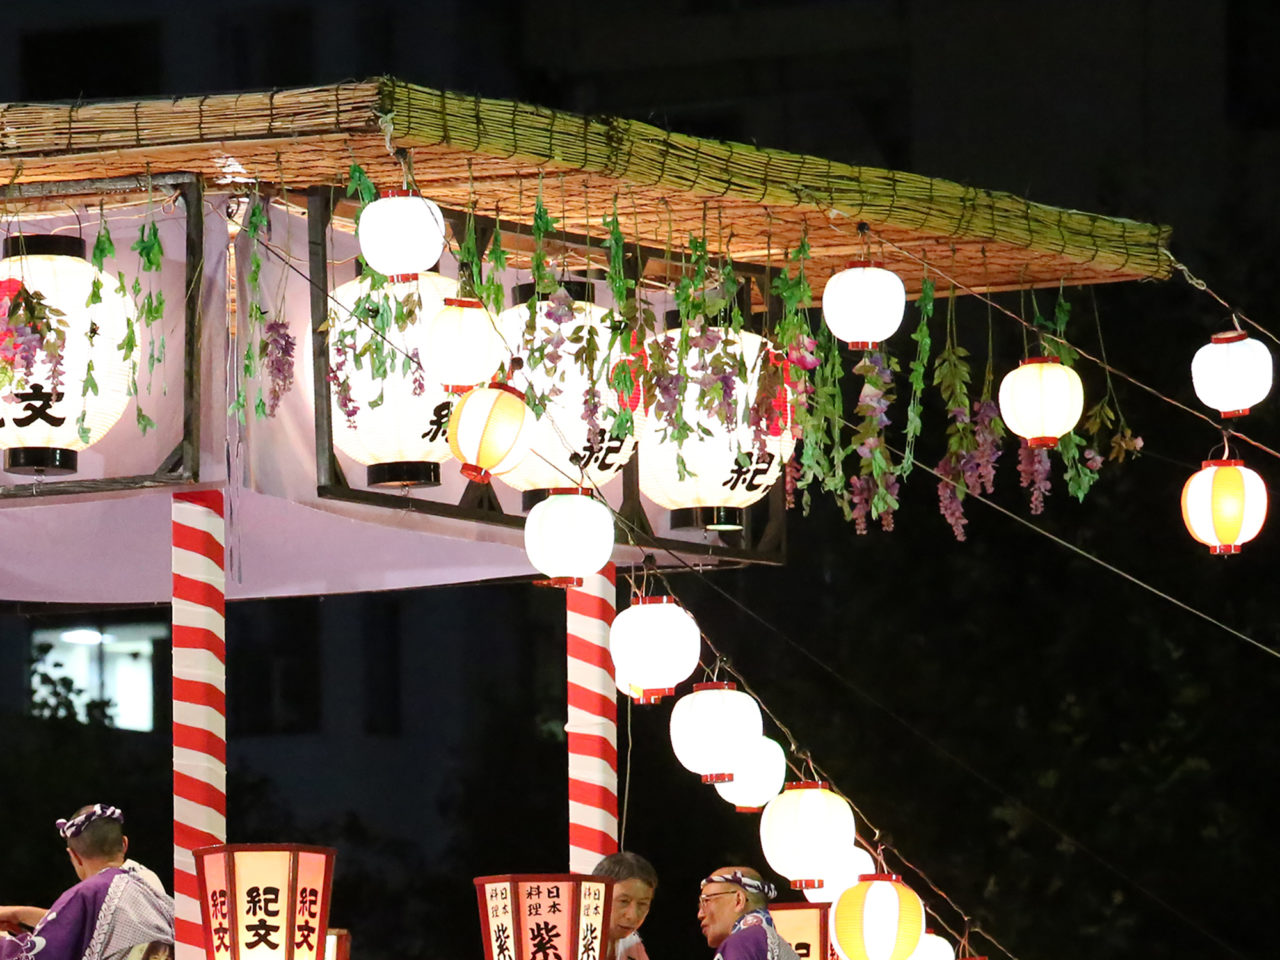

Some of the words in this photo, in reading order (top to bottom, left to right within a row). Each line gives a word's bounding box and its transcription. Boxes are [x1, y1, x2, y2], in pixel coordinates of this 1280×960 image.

[722, 451, 778, 493] 紀
[211, 889, 230, 952] 紀文
[245, 886, 280, 950] 紀文
[295, 887, 318, 952] 紀文
[547, 885, 562, 915] 日本
